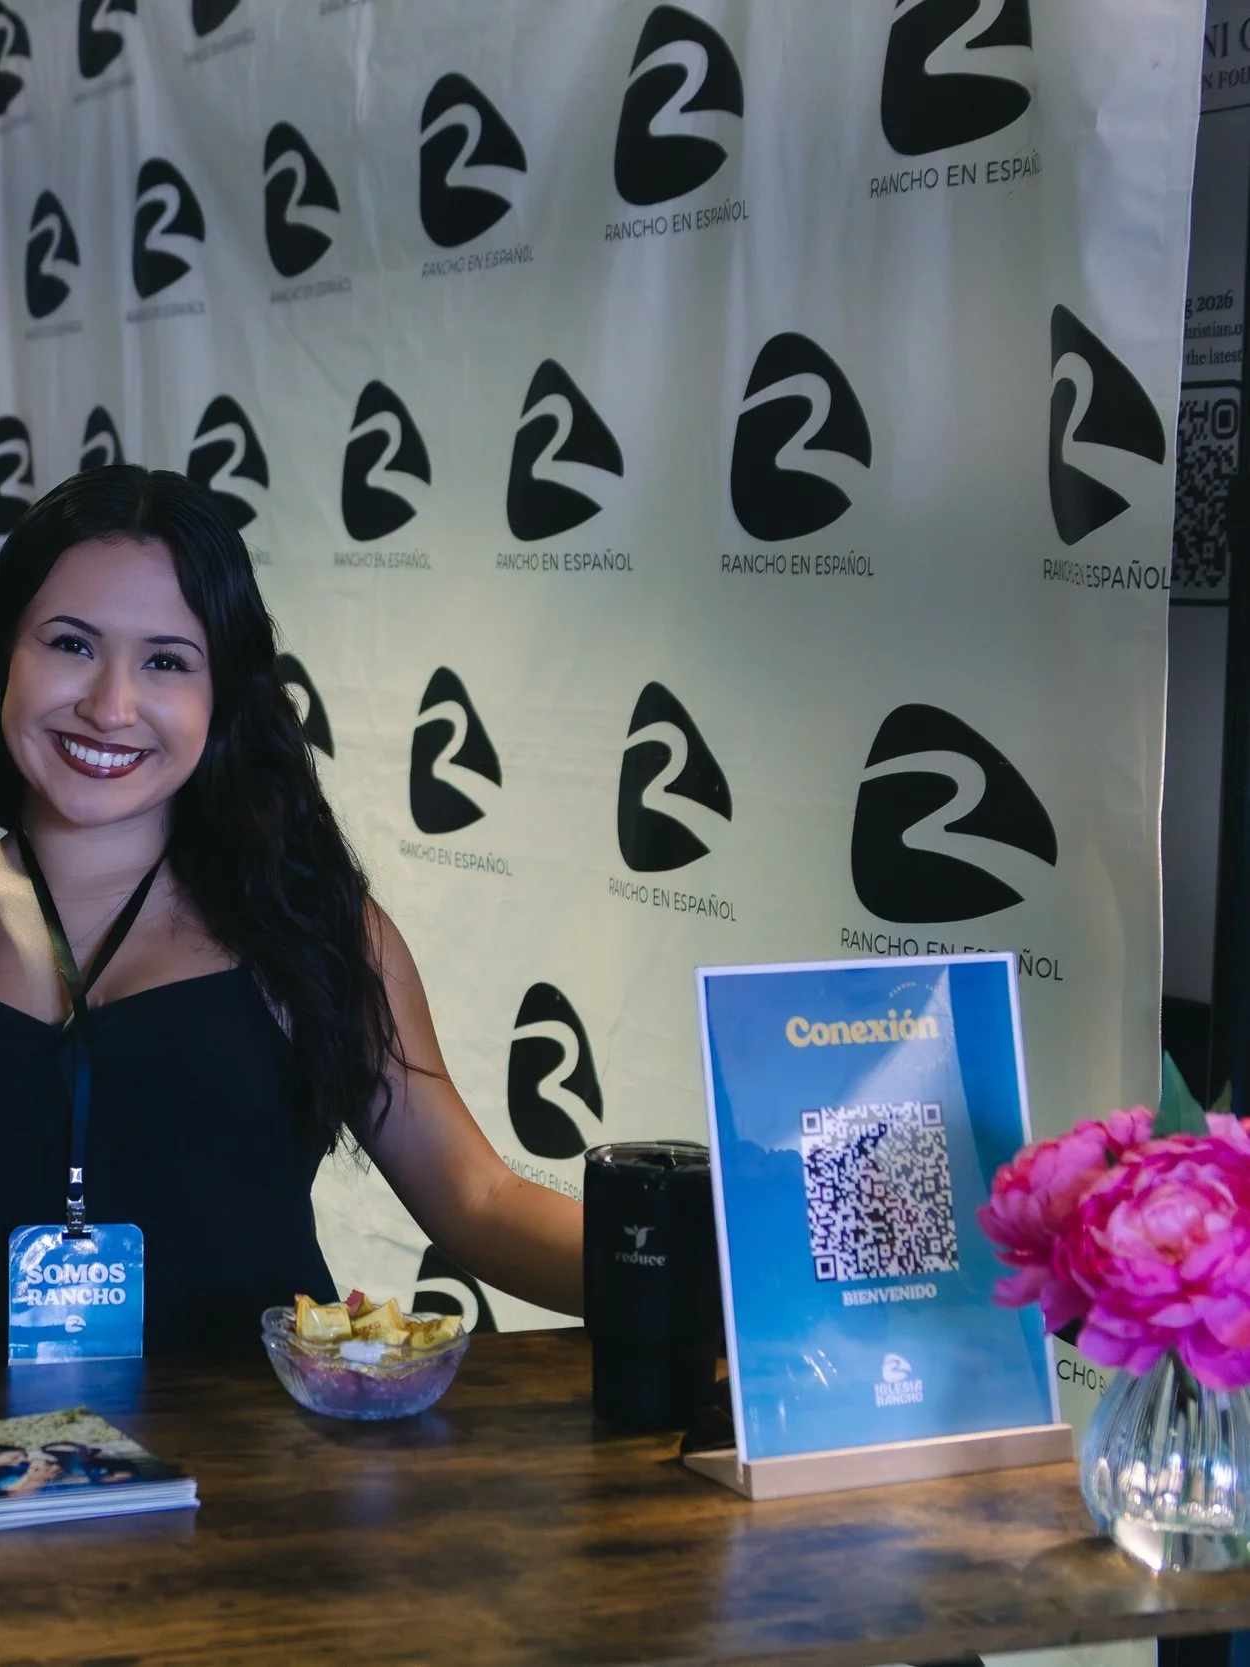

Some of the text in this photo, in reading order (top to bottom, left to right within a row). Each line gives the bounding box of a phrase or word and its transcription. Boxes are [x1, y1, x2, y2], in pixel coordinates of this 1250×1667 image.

[869, 167, 939, 199] RANCHO
[946, 163, 977, 188] EN
[605, 197, 749, 242] RANCHO EN ESPAÑOL
[421, 242, 534, 280] RANCHO EN ESPAÑOL
[1196, 288, 1234, 312] 2026
[496, 548, 634, 572] RANCHO EN ESPAÑOL
[721, 550, 875, 577] RANCHO EN ESPAÑOL
[1086, 560, 1170, 590] ESPAÑOL
[400, 839, 513, 877] RANCHO EN ESPAÑOL
[608, 876, 737, 922] RANCHO EN ESPAÑOL
[841, 927, 919, 957] RANCHO
[785, 1008, 940, 1049] Conexión
[25, 1262, 127, 1285] SOMOS
[614, 1250, 667, 1267] reduce
[27, 1287, 127, 1307] RANCHO
[841, 1283, 938, 1307] BIENVENIDO
[1056, 1359, 1097, 1390] CHO
